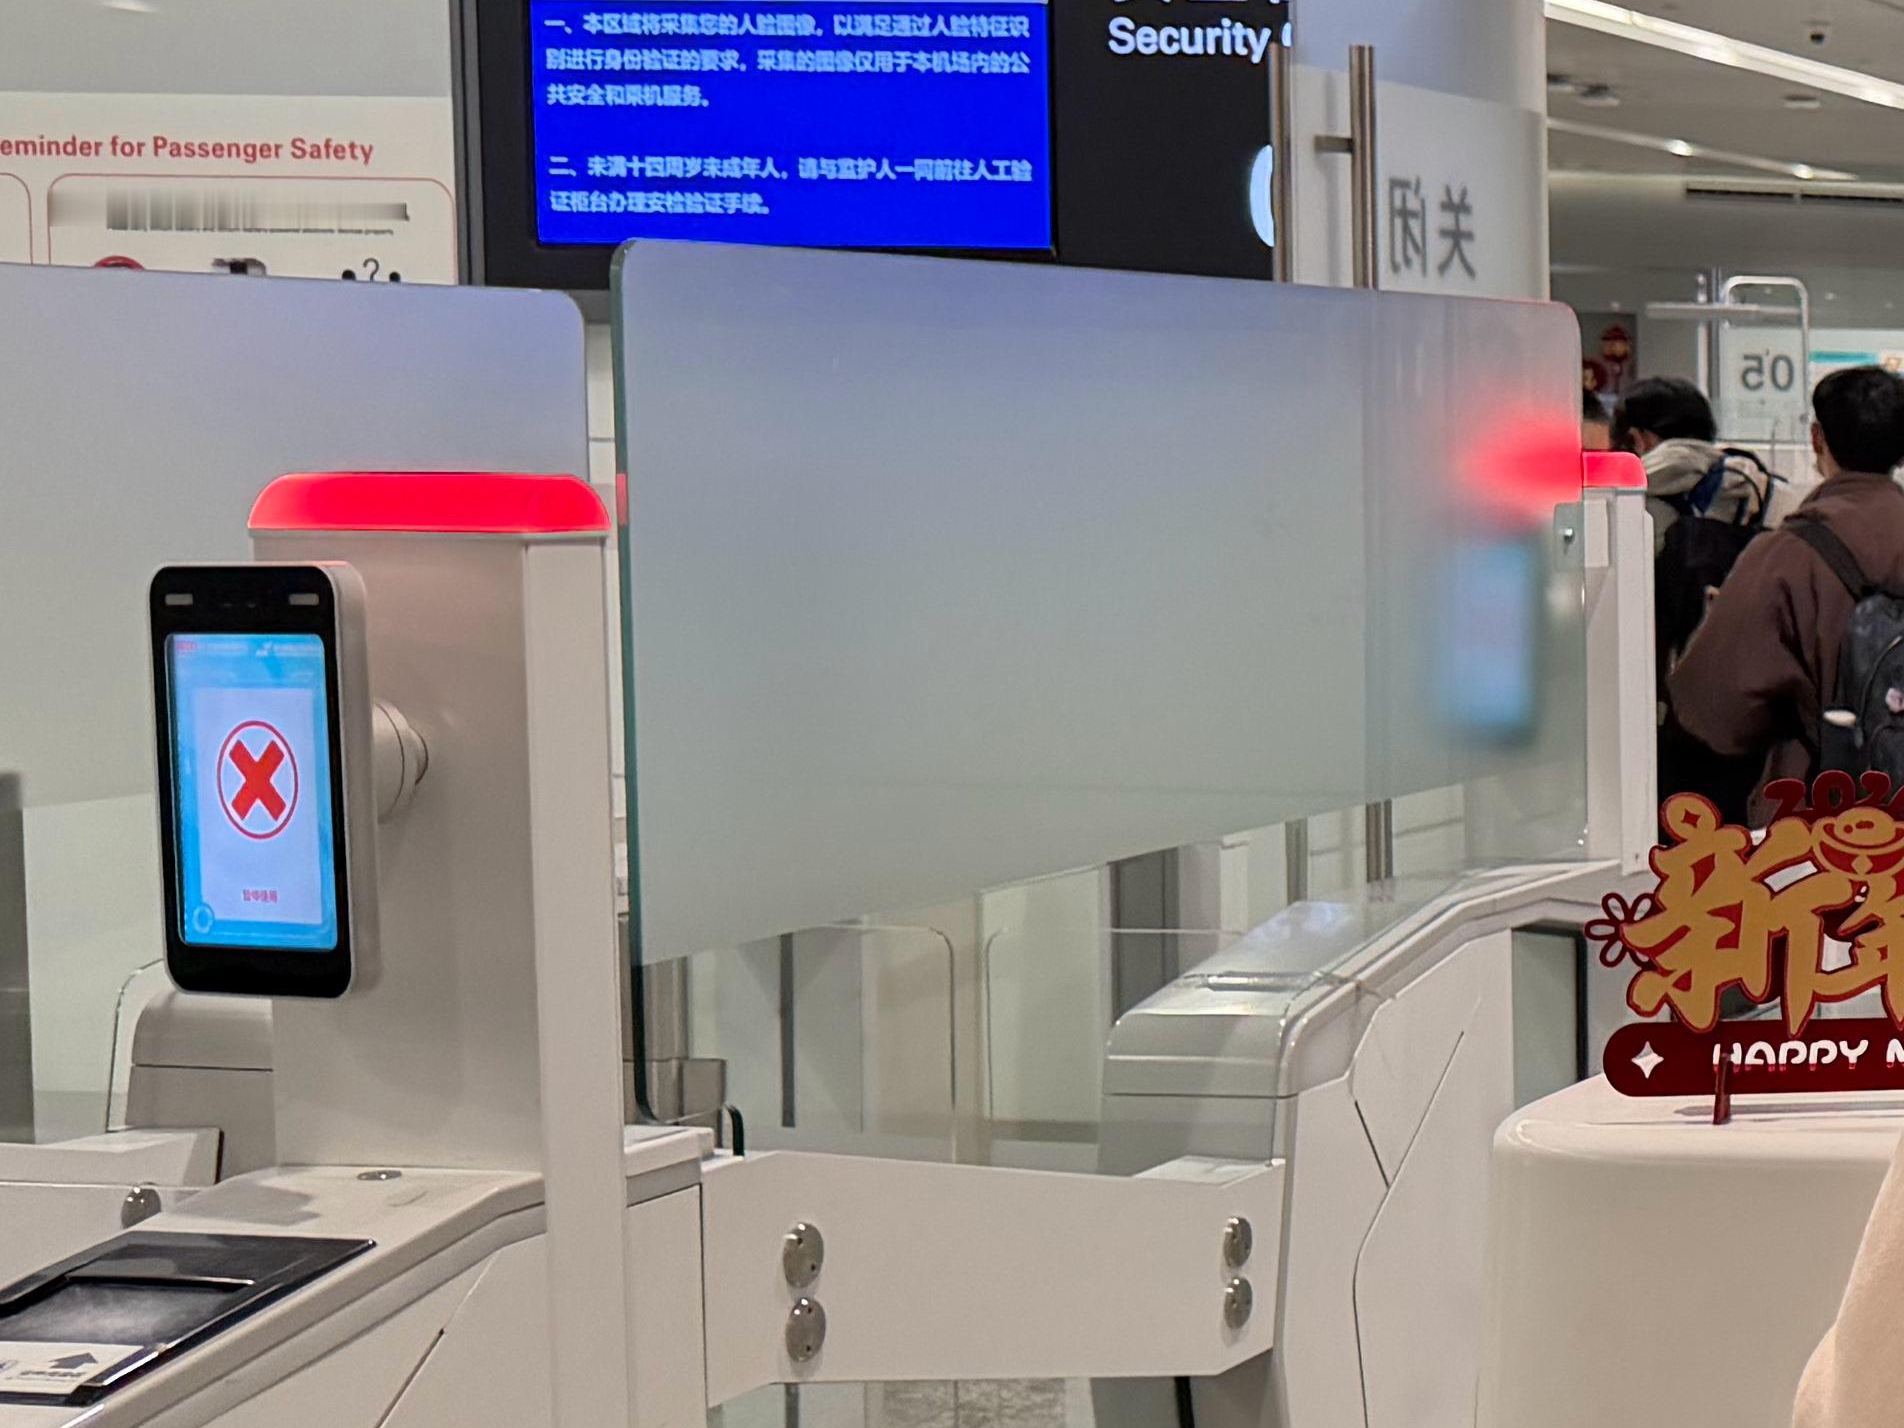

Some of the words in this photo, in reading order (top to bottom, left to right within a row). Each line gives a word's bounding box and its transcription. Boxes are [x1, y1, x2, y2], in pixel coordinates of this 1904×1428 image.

[1108, 16, 1271, 63] Security
[110, 135, 146, 158] for
[152, 135, 283, 164] Passenger
[290, 137, 374, 165] Safety
[1712, 1038, 1870, 1071] HAPPY
